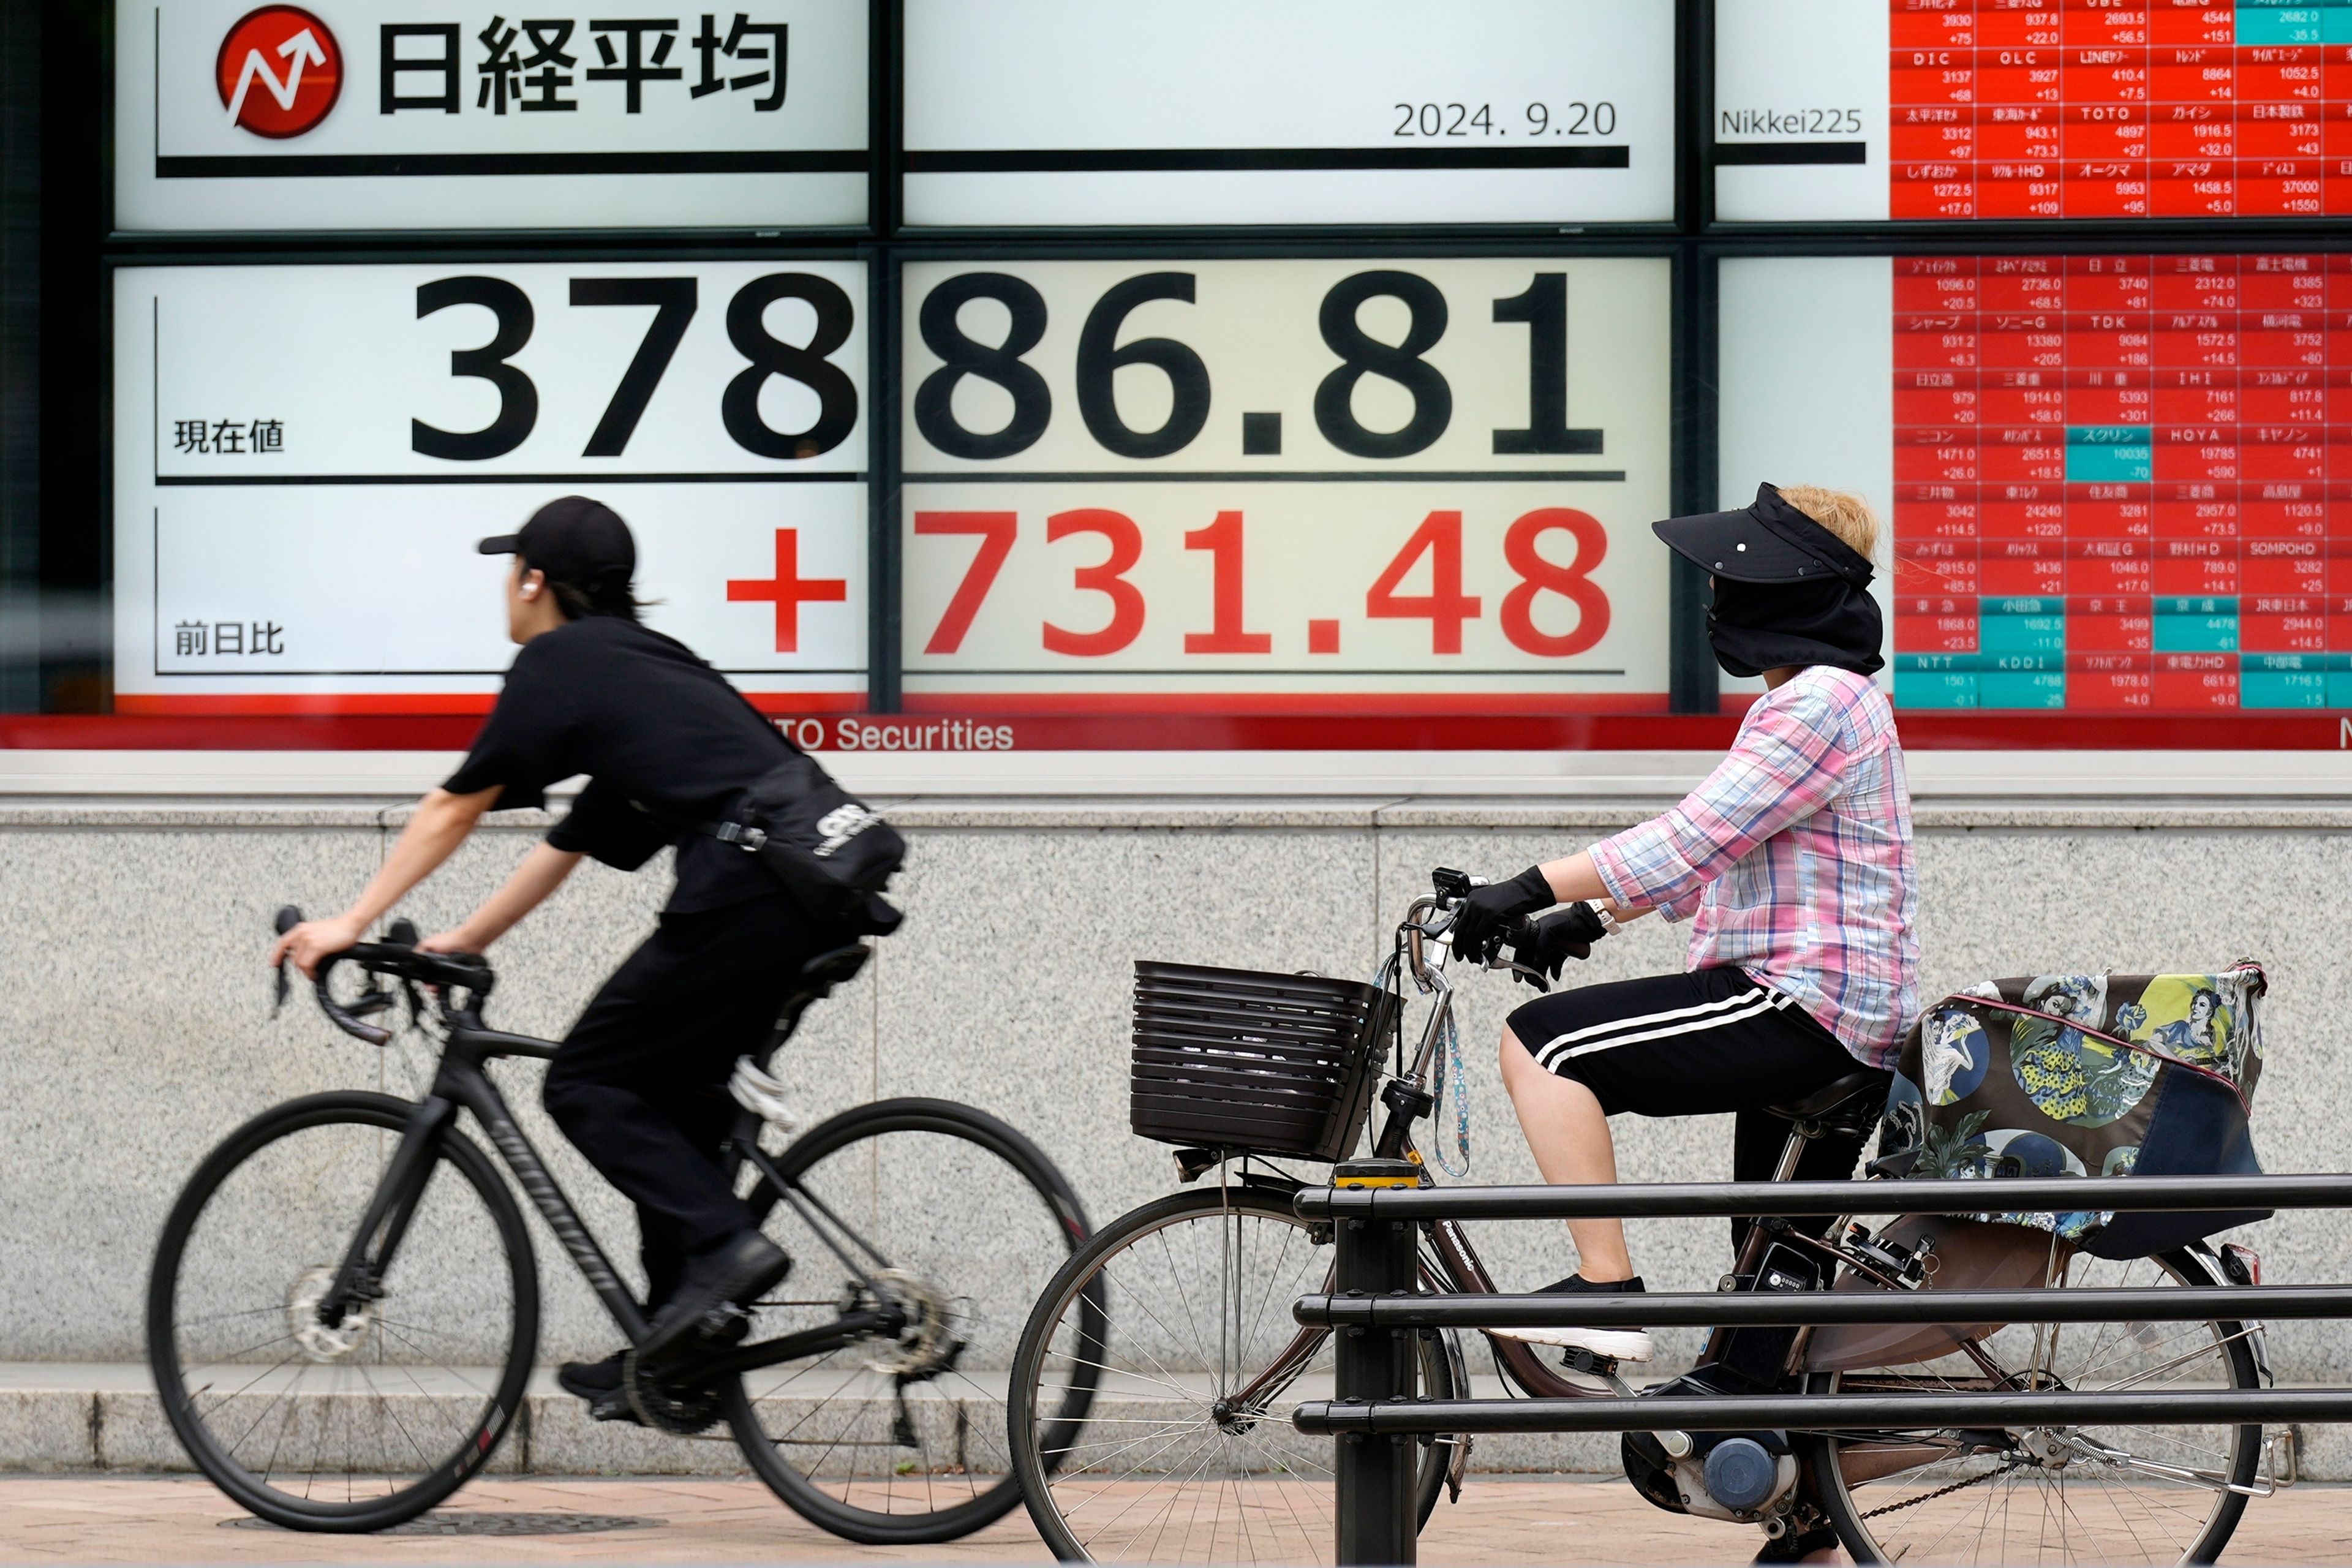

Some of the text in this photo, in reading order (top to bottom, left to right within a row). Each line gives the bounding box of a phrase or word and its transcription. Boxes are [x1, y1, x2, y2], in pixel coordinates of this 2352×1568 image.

[2203, 11, 2231, 23] 4544
[1950, 32, 1972, 45] +75
[2026, 32, 2059, 44] +22.0
[2113, 31, 2145, 43] +56.5
[2203, 30, 2230, 42] +151
[380, 13, 788, 115] 日経平均
[1943, 70, 1972, 83] 3137
[2029, 70, 2058, 82] 3927
[2112, 69, 2144, 81] 410.4
[2203, 68, 2231, 80] 8864
[2280, 67, 2319, 80] 1052.5
[2037, 88, 2059, 100] +13
[2119, 87, 2145, 100] +7.5
[2210, 87, 2231, 98] +14
[2293, 85, 2319, 97] +4.0
[2173, 106, 2211, 119] ガイシ
[2253, 105, 2303, 118] 日本製鉄
[1395, 102, 1615, 136] 2024. 9.20
[1722, 110, 1861, 135] Nikkei225
[1943, 127, 1972, 140] 3312
[2026, 127, 2057, 138] 943.1
[2290, 123, 2319, 136] 3173
[1950, 146, 1972, 158] +97
[2026, 145, 2059, 157] +73.3
[2123, 144, 2145, 157] +27
[2199, 143, 2232, 156] +32.0
[2297, 143, 2319, 154] +43
[1908, 165, 1957, 178] しずおか
[2081, 164, 2130, 176] オークマ
[2174, 163, 2211, 175] アマダ
[1934, 184, 1972, 197] 1272.5
[2193, 181, 2232, 194] 1458.5
[2283, 180, 2319, 193] 37000
[1940, 203, 1972, 214] +17.0
[2030, 202, 2059, 214] +109
[2124, 201, 2145, 213] +95
[2207, 200, 2232, 212] +5.0
[2283, 199, 2319, 211] +1550
[2119, 277, 2149, 290] 3740
[2195, 277, 2235, 290] 2312.0
[1943, 297, 1975, 310] +20.5
[2127, 296, 2147, 308] +81
[2203, 295, 2235, 307] +74.0
[2294, 295, 2323, 307] +323
[2091, 316, 2124, 328] TDK
[2197, 334, 2235, 346] 1572.5
[2294, 333, 2323, 346] 3752
[2033, 353, 2062, 366] +205
[2203, 352, 2235, 364] +14.5
[1953, 392, 1976, 404] 979
[2024, 391, 2062, 404] 1914.0
[2207, 391, 2234, 403] 7161
[1954, 410, 1976, 423] +20
[2120, 410, 2147, 421] +301
[2207, 409, 2235, 421] +266
[2290, 409, 2322, 420] +11.4
[175, 420, 284, 454] 現在値
[1918, 431, 1953, 442] ニコン
[1937, 448, 1976, 461] 1471.0
[2022, 448, 2063, 461] 2651.5
[2293, 447, 2321, 458] 4741
[1943, 467, 1976, 479] +26.0
[2308, 466, 2322, 477] +1
[1947, 505, 1976, 518] 3042
[2026, 505, 2062, 518] 24240
[1937, 523, 1976, 535] +114.5
[2027, 523, 2063, 536] +1220
[2127, 523, 2149, 535] +64
[2204, 522, 2236, 535] +73.5
[2297, 522, 2323, 535] +9.0
[1936, 562, 1976, 574] 2915.0
[2041, 580, 2061, 592] +21
[2117, 579, 2150, 592] +17.0
[2204, 580, 2234, 591] +14.1
[2302, 579, 2323, 592] +25
[2256, 599, 2307, 611] JR東日本
[176, 621, 284, 655] 前日比
[1943, 636, 1976, 649] +23.5
[2128, 636, 2150, 649] +35
[2291, 636, 2323, 648] +14.5
[1918, 656, 1952, 668] NTT
[2111, 674, 2149, 687] 1978.0
[2203, 674, 2237, 687] 661.9
[2124, 693, 2150, 705] +4.0
[2211, 693, 2237, 706] +9.0
[773, 718, 1014, 750] TO Securities
[1442, 1220, 1474, 1272] Panasonic
